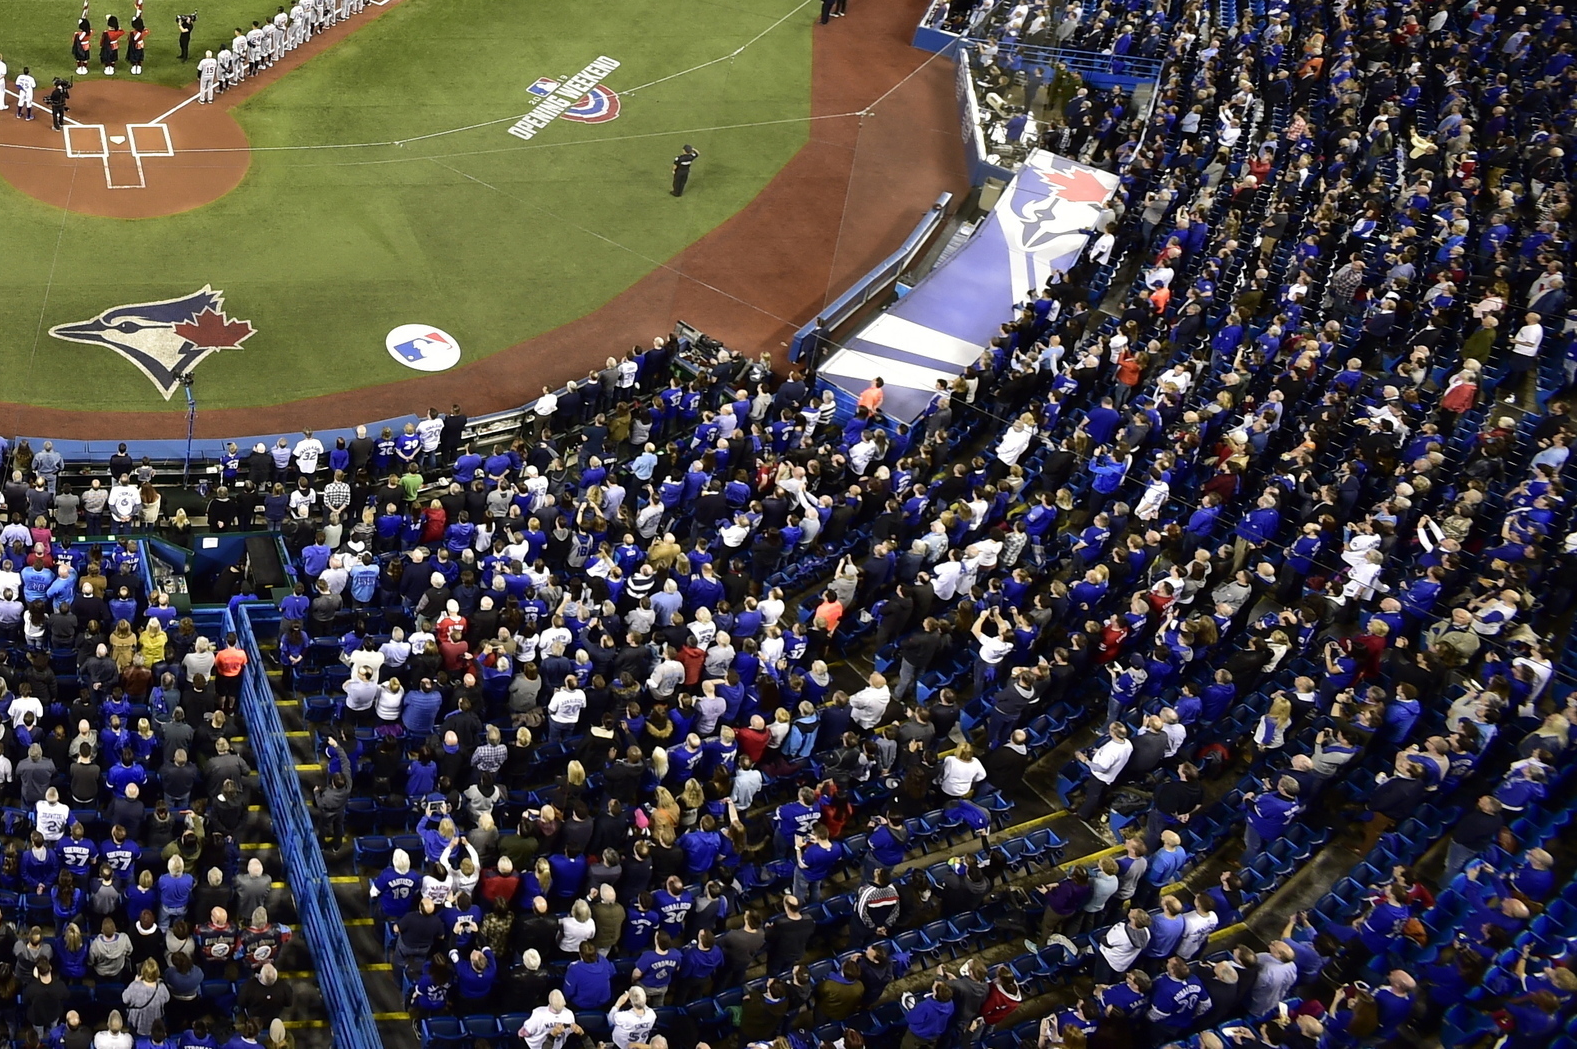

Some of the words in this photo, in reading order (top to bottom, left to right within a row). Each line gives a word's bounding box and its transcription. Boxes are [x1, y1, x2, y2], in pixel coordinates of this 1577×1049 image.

[205, 66, 214, 75] 15
[528, 96, 542, 106] 20
[556, 74, 569, 83] 19
[507, 94, 572, 141] OPENING
[554, 55, 621, 100] WEEKEND
[427, 429, 441, 438] 20
[404, 439, 419, 450] 29
[302, 451, 317, 461] 32
[379, 448, 394, 456] 20
[121, 497, 129, 507] 6
[790, 649, 806, 660] 37
[563, 703, 580, 714] 20
[794, 812, 822, 824] DONALDSON
[47, 821, 57, 832] 2
[64, 853, 86, 867] 27
[113, 856, 129, 871] 27
[387, 876, 415, 888] BAUTISTA
[391, 887, 410, 900] 19
[428, 885, 450, 893] MARTIN
[661, 902, 692, 913] DONALDSON
[667, 909, 687, 923] 20
[635, 925, 644, 935] 2
[651, 960, 677, 971] STROMAN
[1173, 984, 1202, 1003] DONALDSON
[1176, 994, 1199, 1014] 20
[627, 1028, 650, 1043] 59
